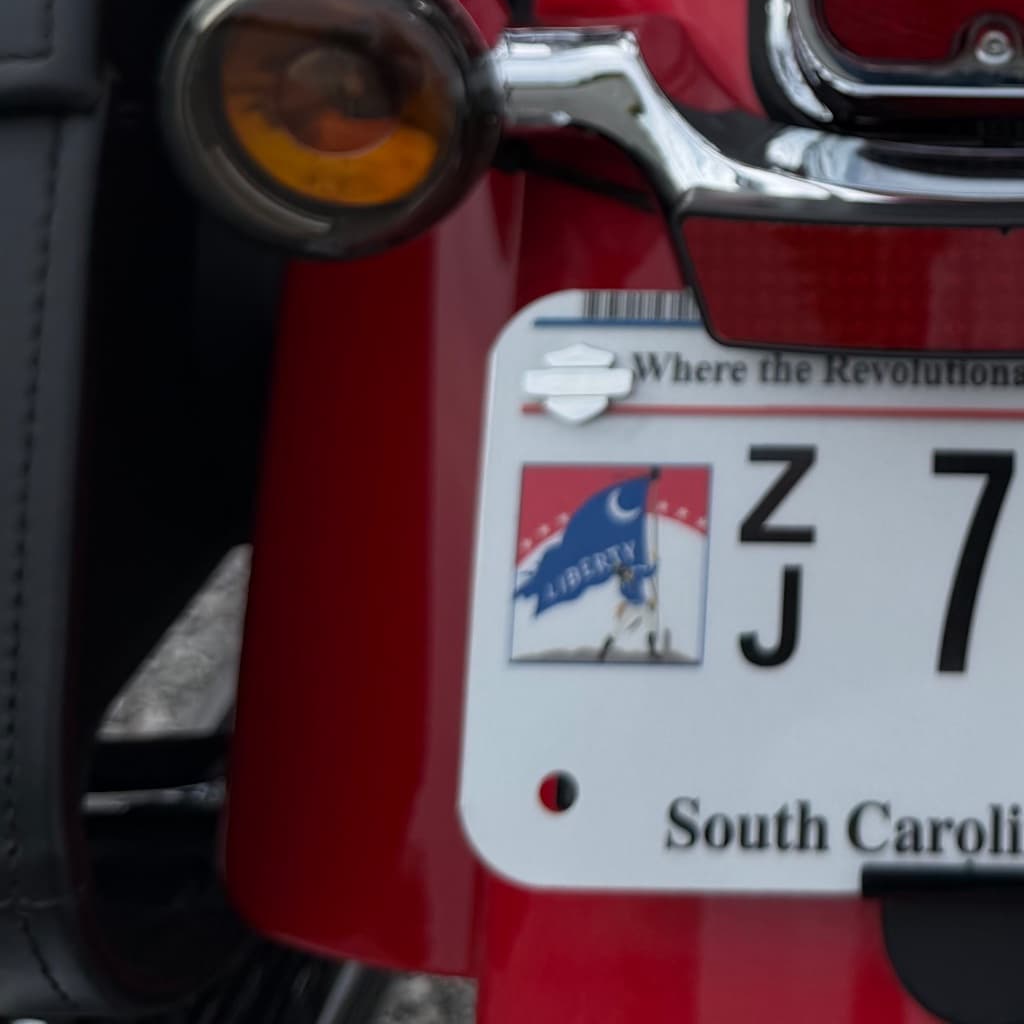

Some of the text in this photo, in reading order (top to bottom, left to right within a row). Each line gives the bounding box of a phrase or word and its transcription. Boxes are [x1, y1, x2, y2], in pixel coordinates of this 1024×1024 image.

[632, 351, 749, 385] Where
[759, 350, 813, 385] the
[545, 539, 636, 602] LIBERTY
[665, 796, 829, 851] South
